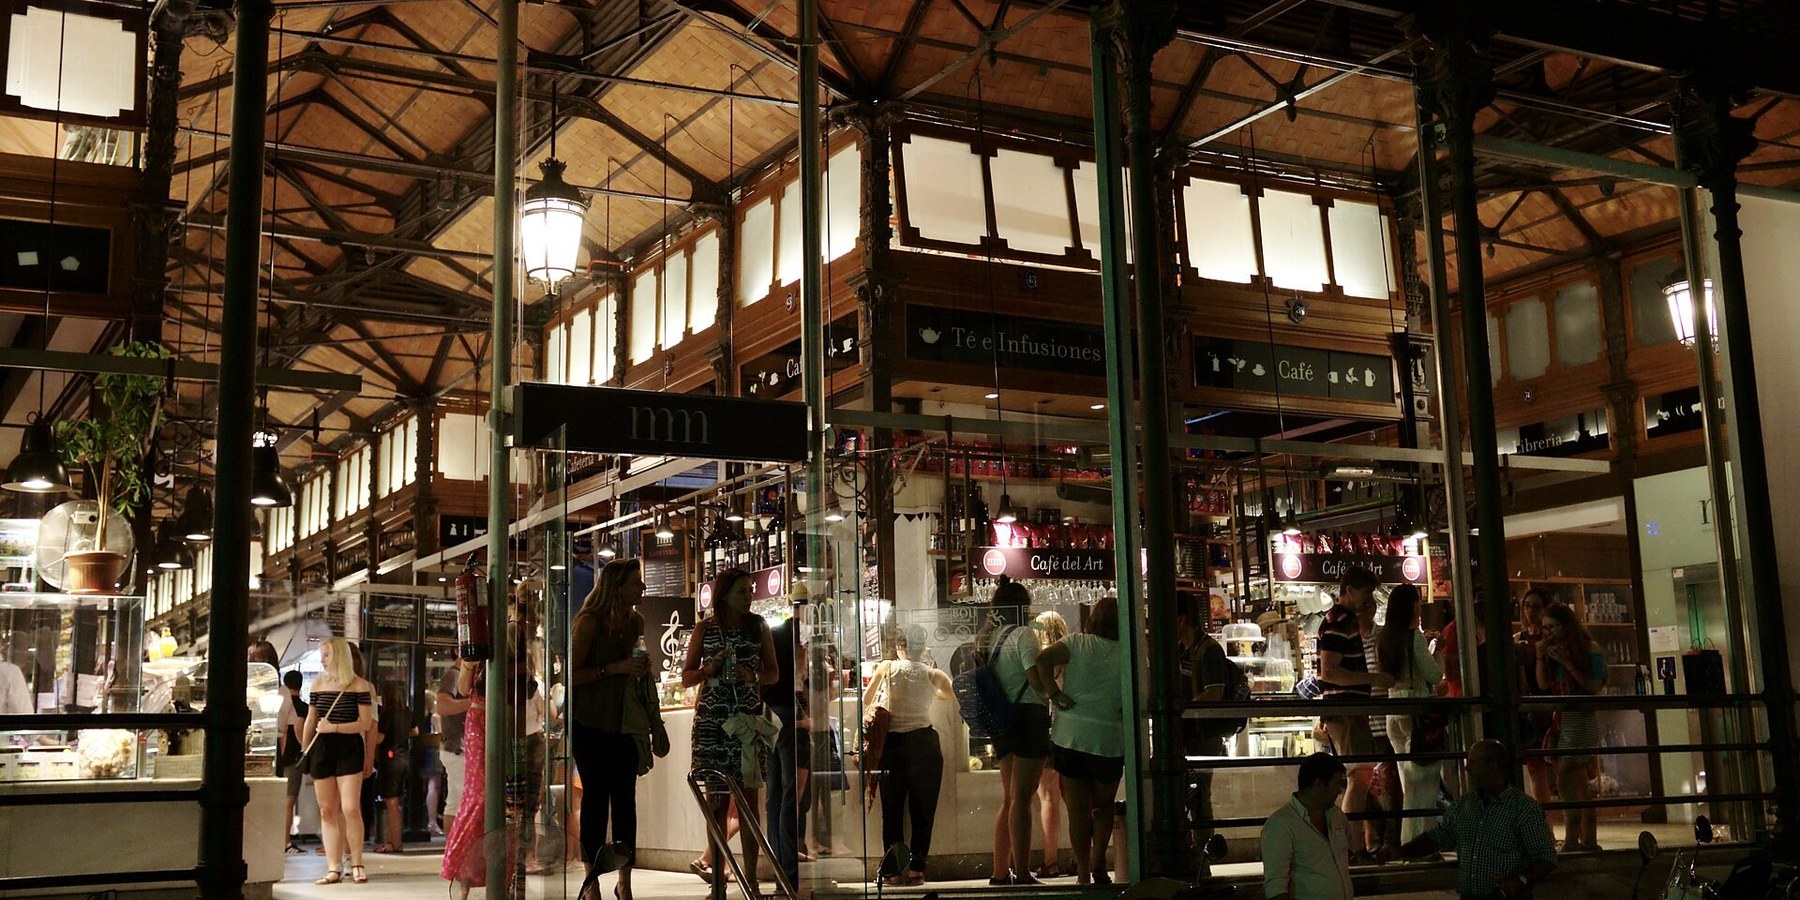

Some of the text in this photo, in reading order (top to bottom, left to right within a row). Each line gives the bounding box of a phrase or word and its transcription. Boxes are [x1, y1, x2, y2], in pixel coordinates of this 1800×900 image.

[951, 326, 1101, 362] Té e Infusiones
[1278, 360, 1314, 381] Café
[1030, 554, 1060, 575] Café
[1062, 555, 1081, 571] del
[1083, 556, 1104, 571] Art
[1322, 560, 1347, 579] Café
